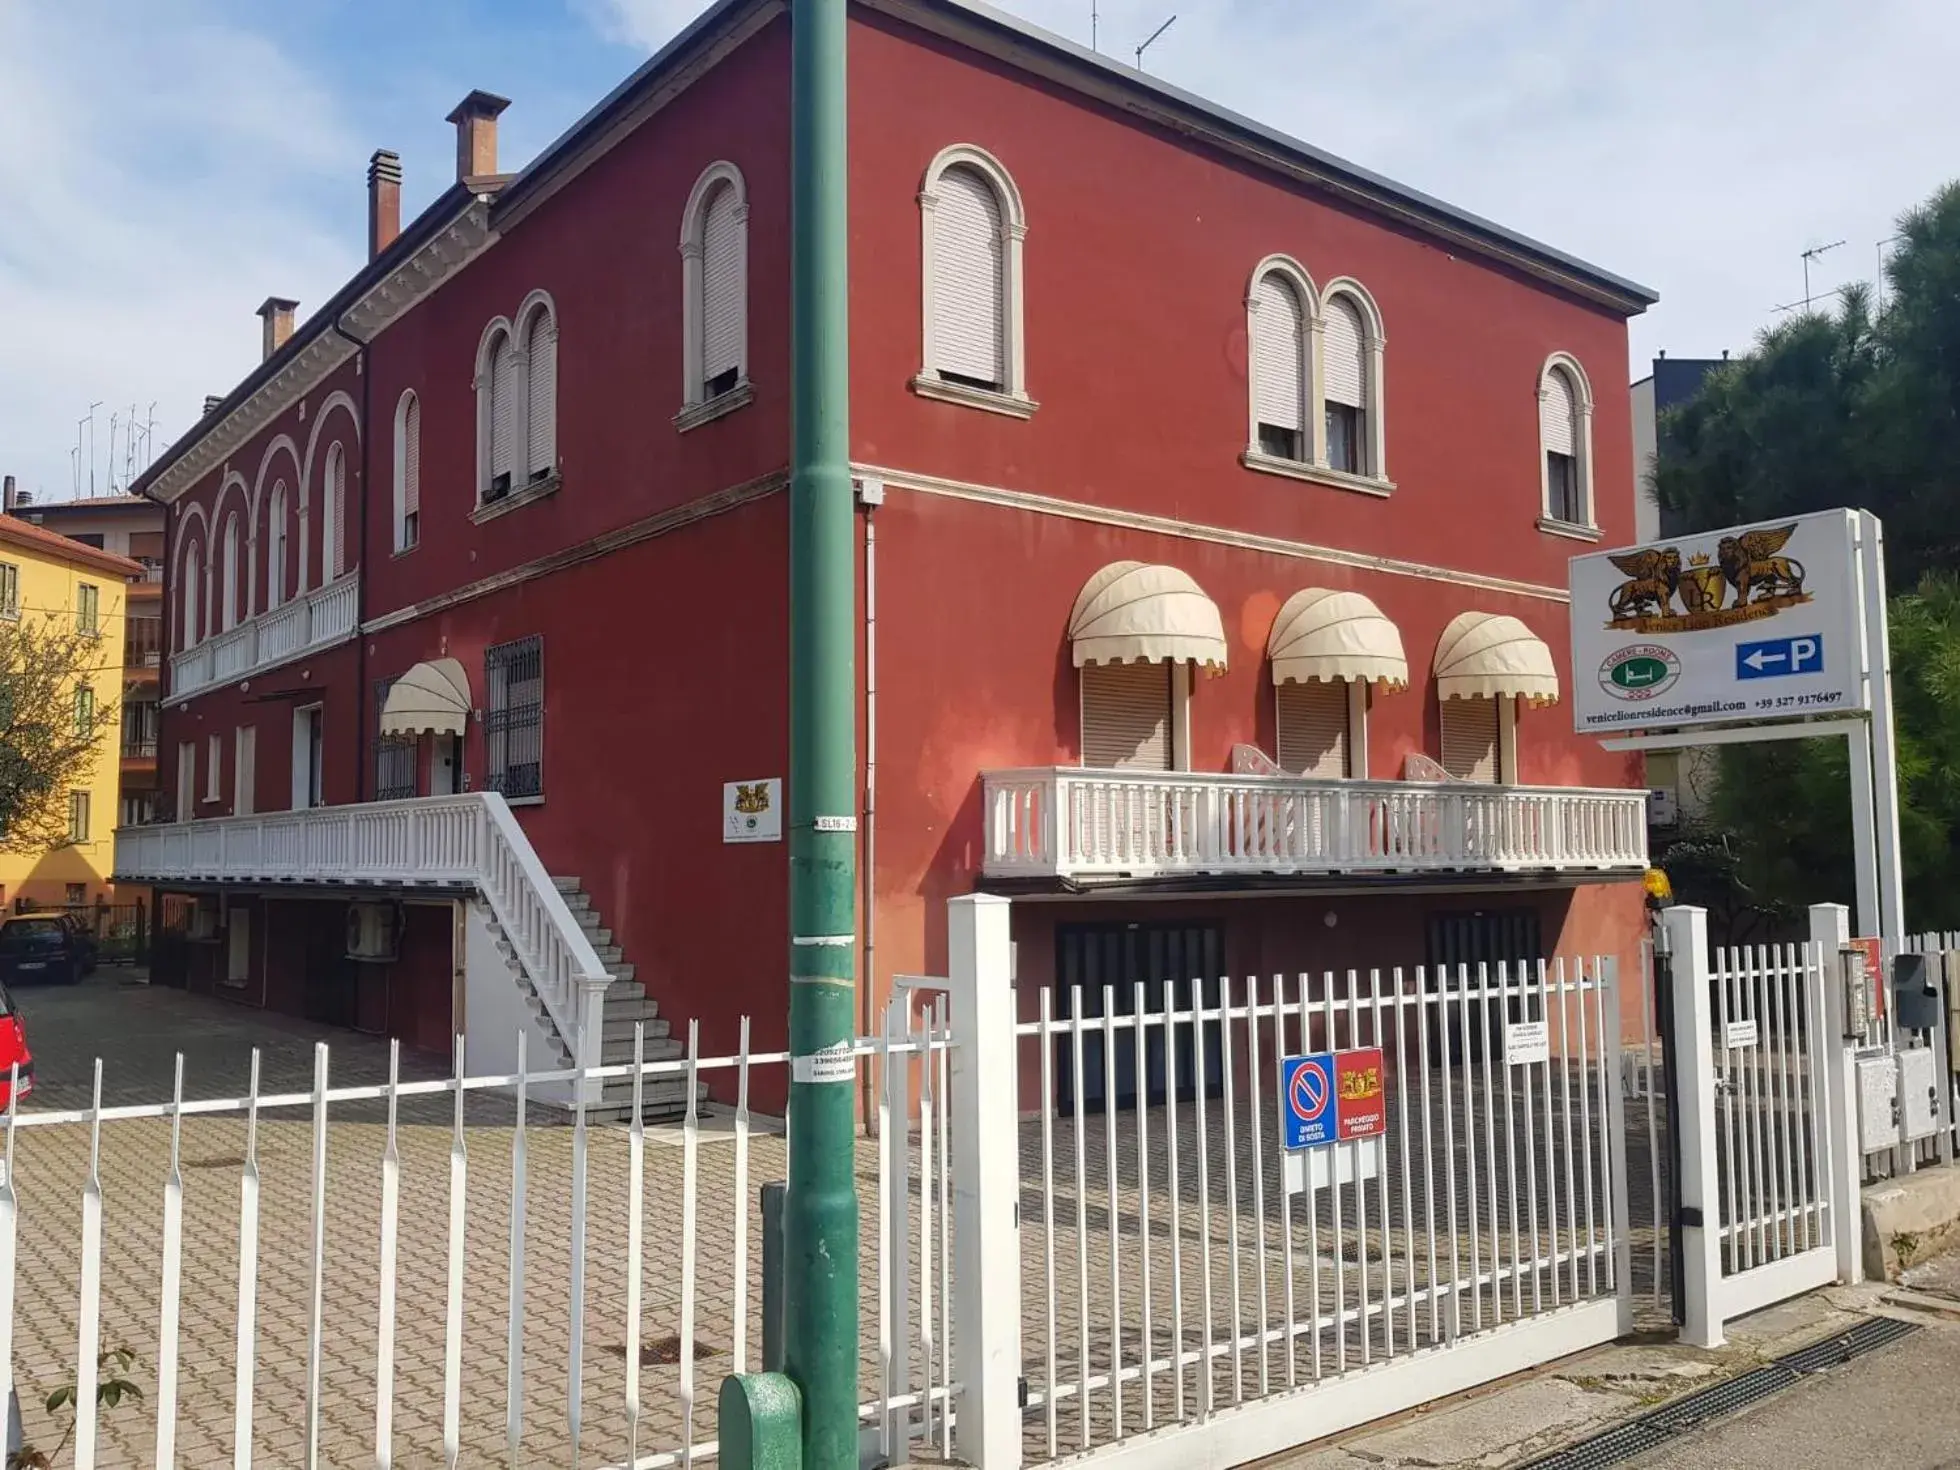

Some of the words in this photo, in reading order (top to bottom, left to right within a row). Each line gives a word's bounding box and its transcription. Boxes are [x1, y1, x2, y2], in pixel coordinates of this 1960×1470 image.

[1791, 639, 1816, 672] P
[1586, 700, 1746, 723] venicelionresidence@gmail.com
[1776, 696, 1794, 708] 327
[1797, 691, 1842, 705] 9176497
